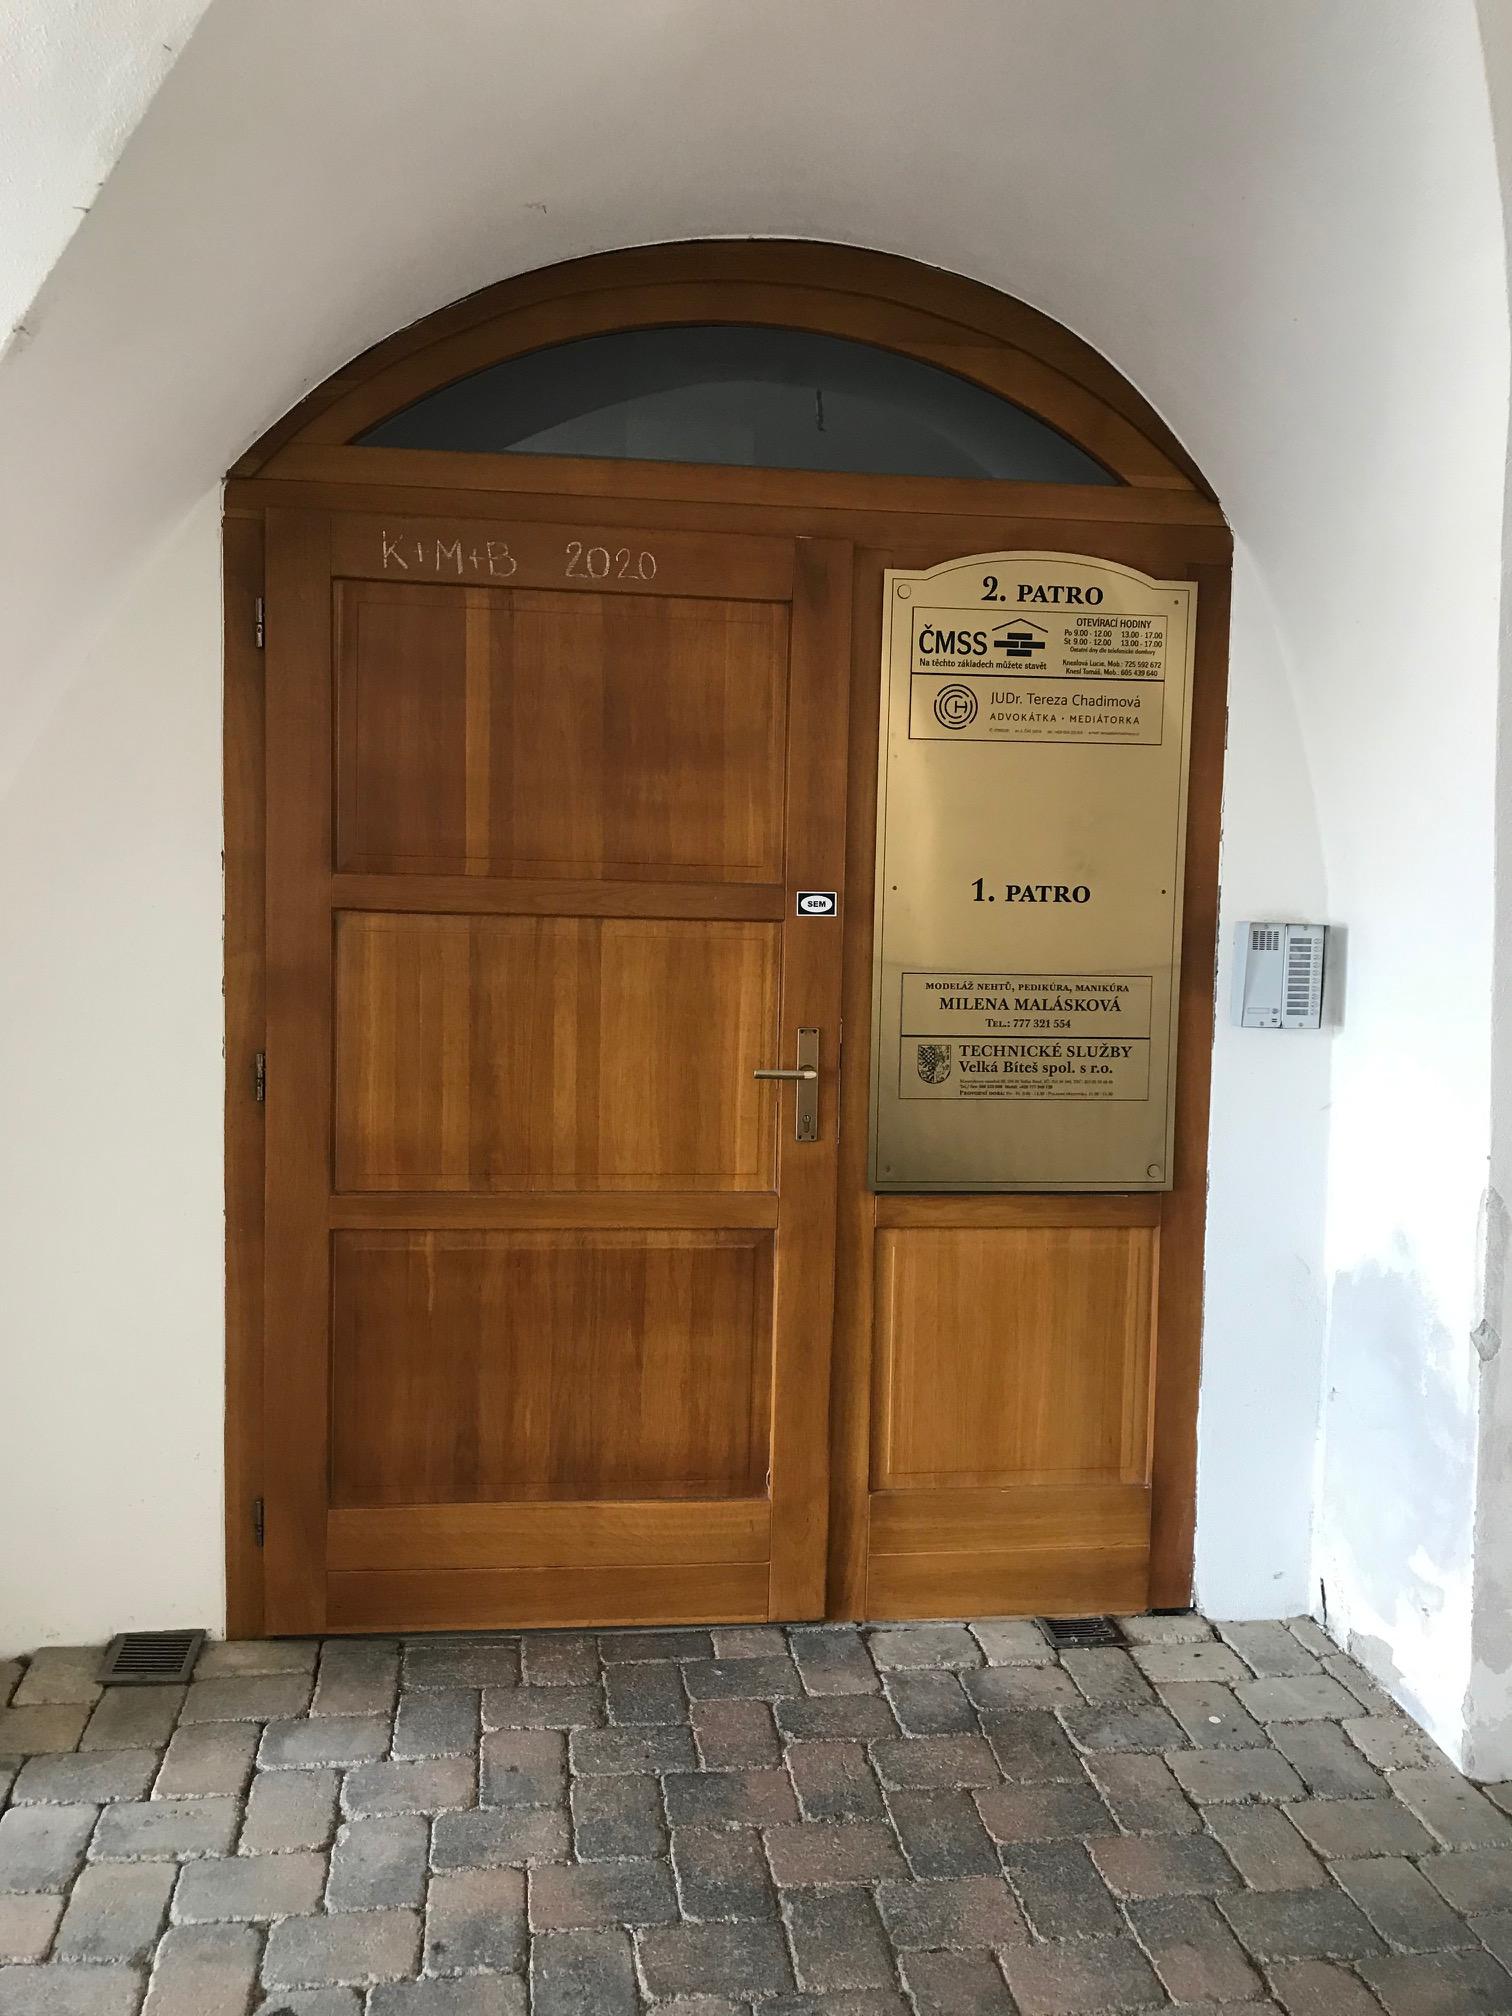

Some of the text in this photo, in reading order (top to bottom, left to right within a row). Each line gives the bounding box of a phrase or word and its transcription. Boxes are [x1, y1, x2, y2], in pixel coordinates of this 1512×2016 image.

[565, 541, 657, 580] 2020
[981, 576, 1104, 606] 2. PATRO
[1076, 617, 1152, 629] OTEVÍRACÍ HODINY
[918, 623, 988, 656] ČMSS
[1064, 629, 1073, 637] Po
[1074, 629, 1088, 637] 9.00
[1094, 630, 1112, 638] 12.00
[1121, 631, 1140, 639] 13.00
[1144, 632, 1163, 640] 17.00
[920, 658, 1047, 670] Na těchto základech můžete stavět
[990, 691, 1142, 708] JUDr. Tereza Chadimová
[990, 712, 1140, 725] ADVOKÁTKA MEDIÁTORKA
[971, 877, 1091, 904] 1. PATRO
[925, 980, 1130, 993] MODELÁŽ NEHTŮ, PEDIKÚRA, MANIKÚRA
[939, 996, 1122, 1012] MILENA MALÁSKOVÁ
[1013, 1018, 1031, 1029] 777
[1033, 1018, 1051, 1029] 321
[1053, 1018, 1072, 1029] 554
[959, 1042, 1133, 1058] TECHNICKÉ SLUŽBY
[959, 1060, 1113, 1077] Velká Bíteš spol. s r.o.
